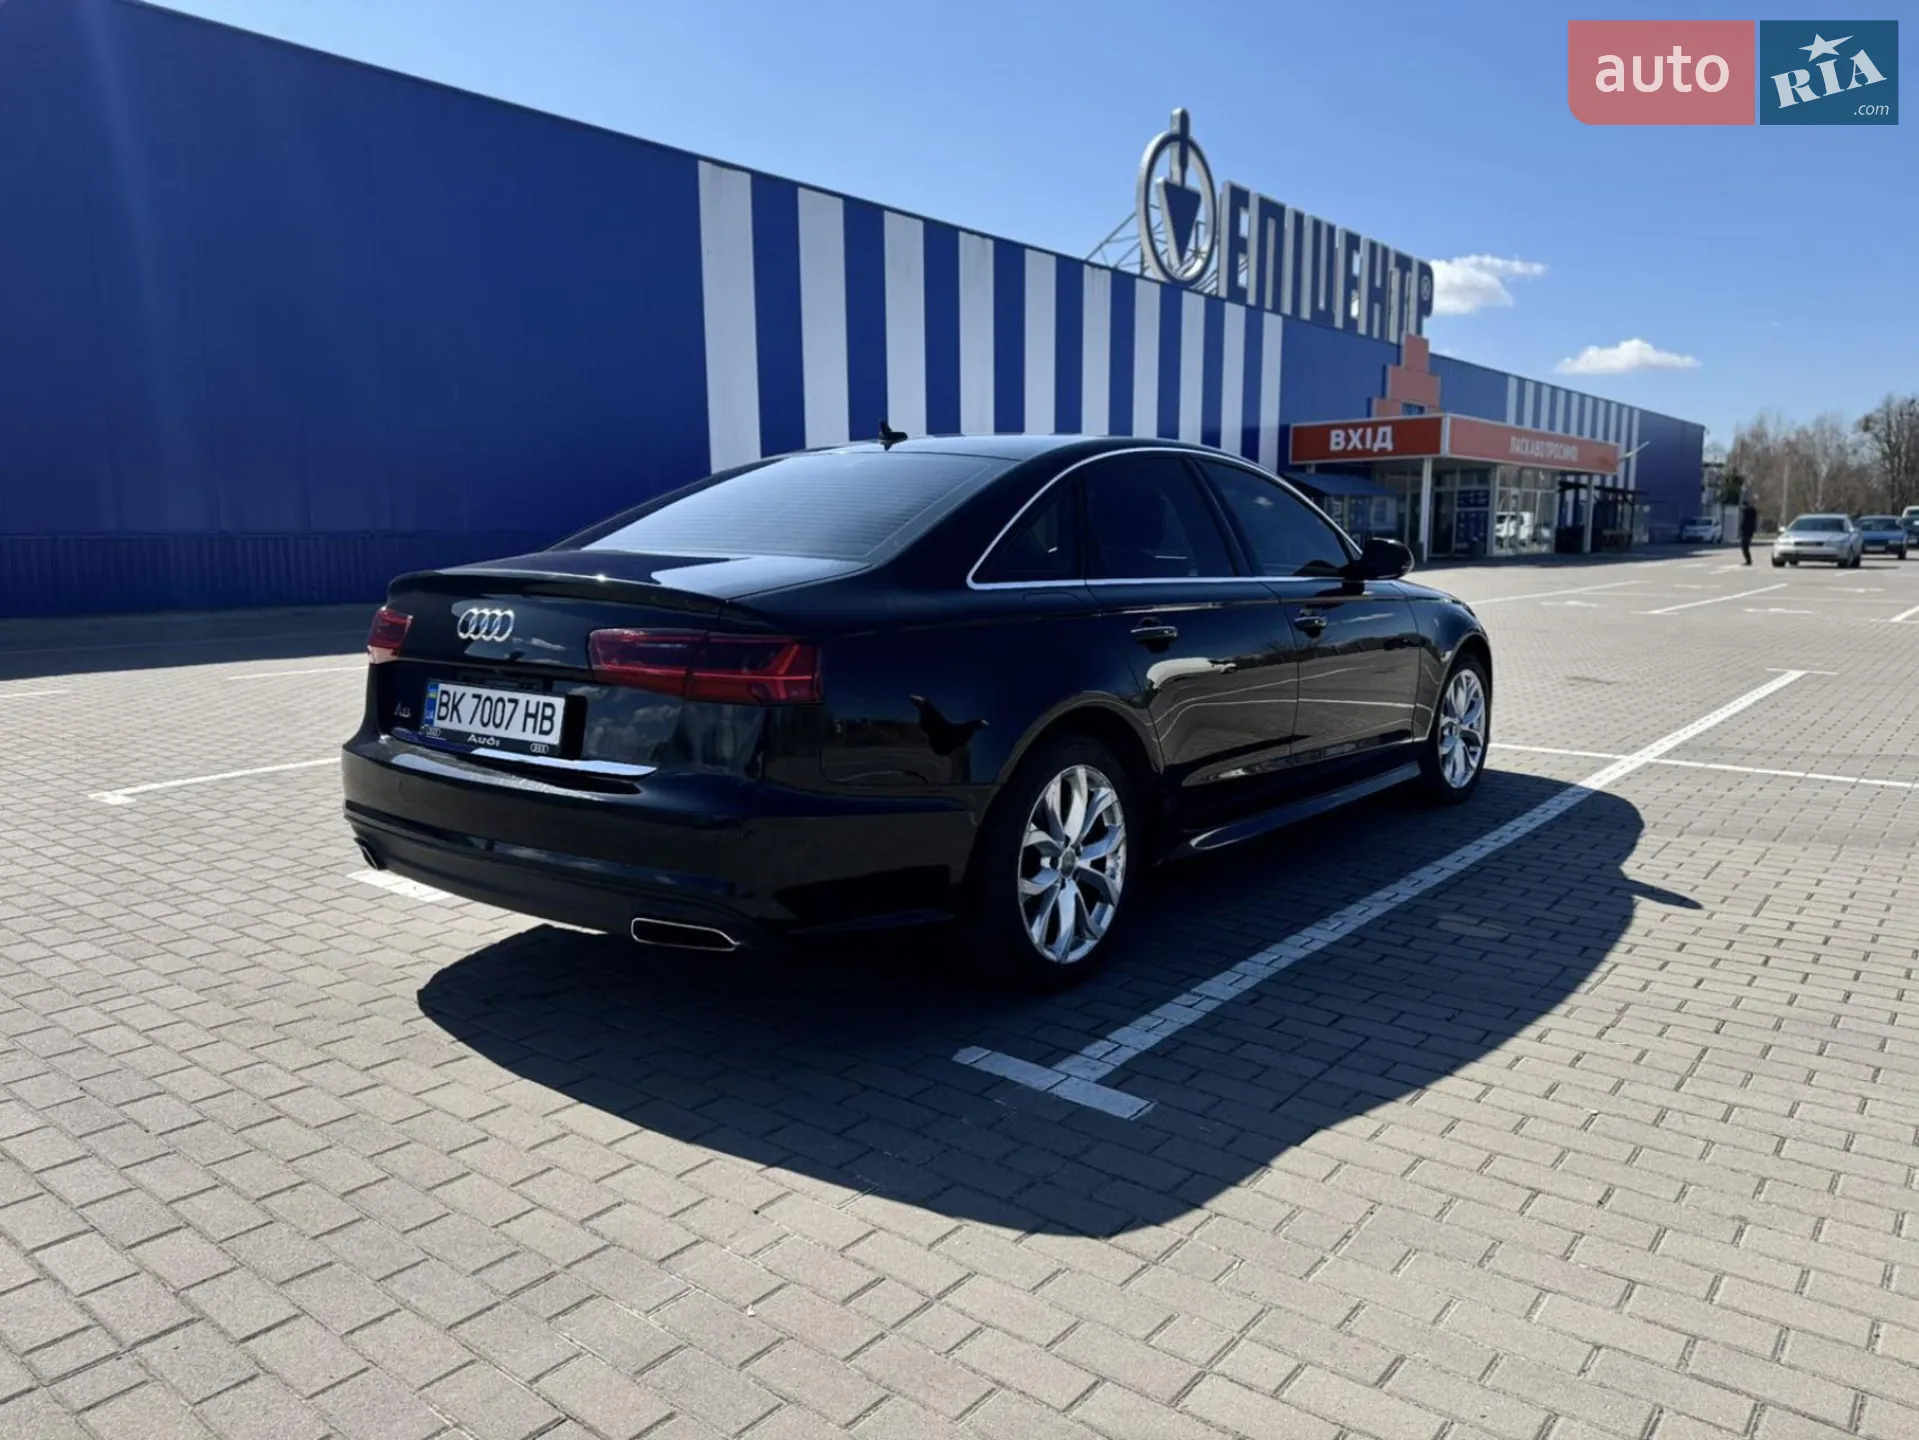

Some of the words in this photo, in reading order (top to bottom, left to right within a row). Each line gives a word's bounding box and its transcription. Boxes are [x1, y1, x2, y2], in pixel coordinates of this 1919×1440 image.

[1330, 425, 1393, 453] ВХІД
[437, 690, 466, 724] BK
[469, 693, 519, 731] 7007
[522, 699, 556, 736] HB
[467, 734, 500, 747] Audi
